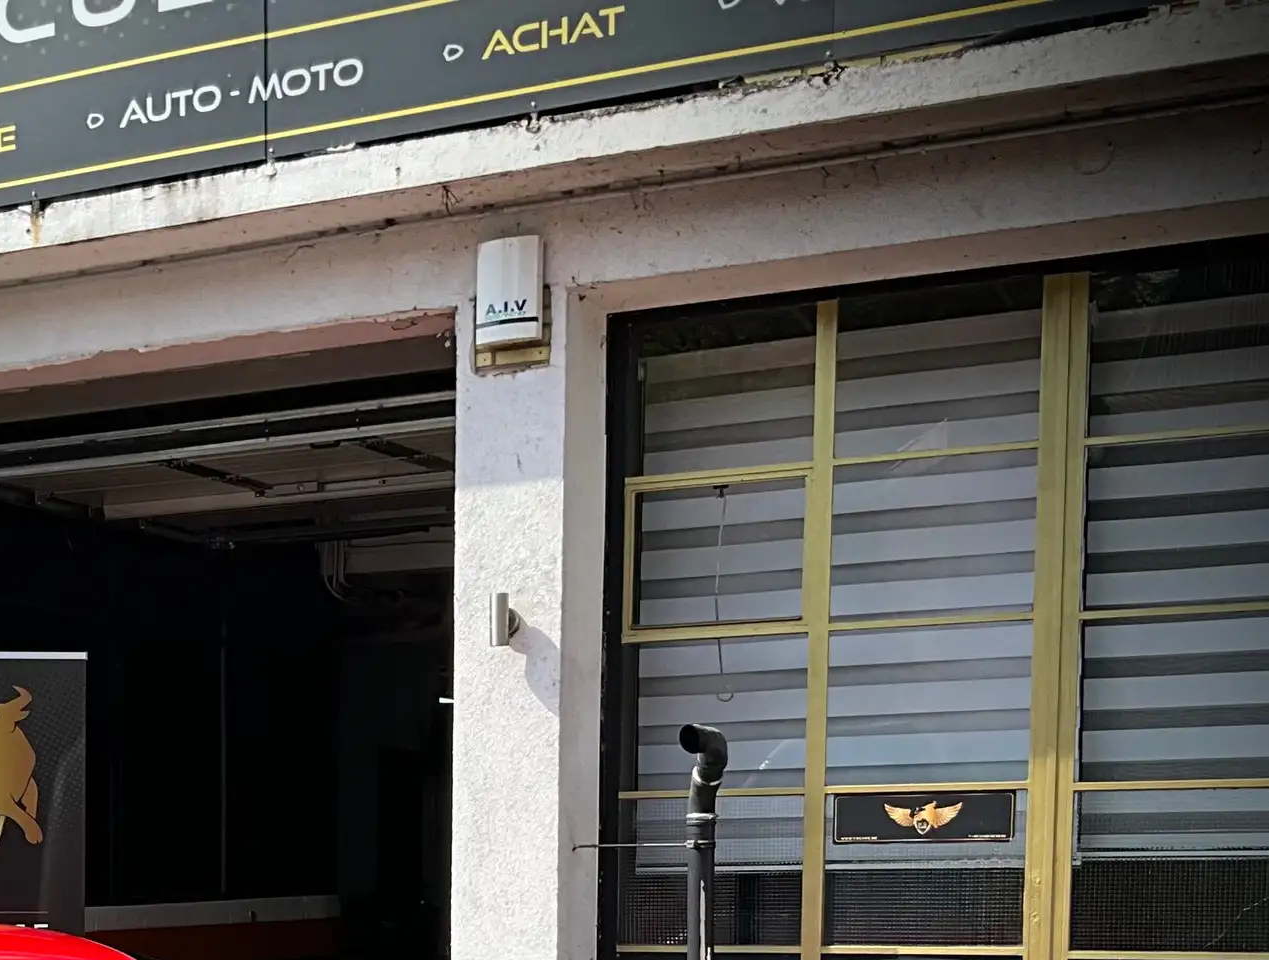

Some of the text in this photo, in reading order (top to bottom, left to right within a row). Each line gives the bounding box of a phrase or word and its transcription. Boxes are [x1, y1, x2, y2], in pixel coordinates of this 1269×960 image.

[482, 5, 625, 60] ACHAT
[119, 84, 220, 128] AUTO
[248, 57, 364, 104] MOTO
[486, 299, 527, 316] A.I.V
